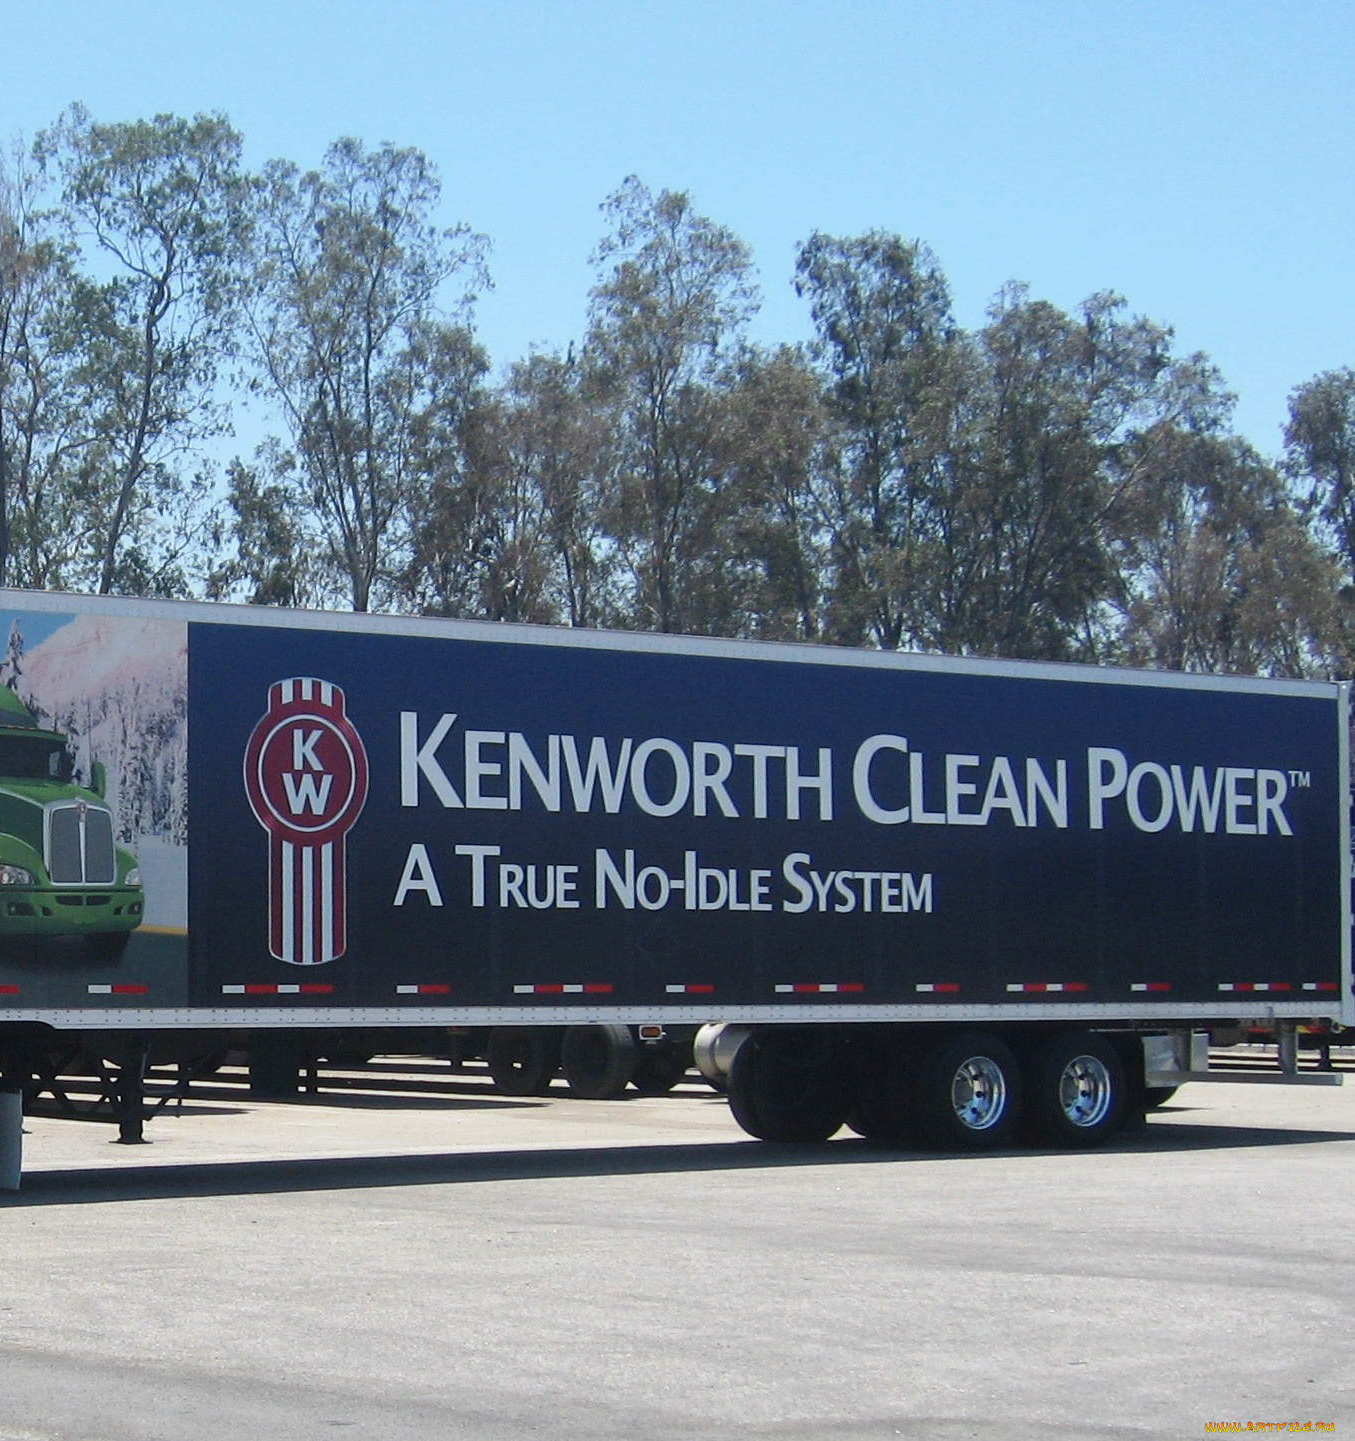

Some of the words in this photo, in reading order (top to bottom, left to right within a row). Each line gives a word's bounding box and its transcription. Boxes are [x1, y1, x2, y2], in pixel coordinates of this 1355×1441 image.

[400, 711, 833, 821] KENWORTH
[852, 734, 1068, 828] CLEAN
[1087, 747, 1293, 836] POWER
[393, 843, 443, 907] A
[454, 844, 580, 909] TRUE
[595, 848, 773, 911] NO-IDLE
[782, 852, 933, 914] SYSTEM
